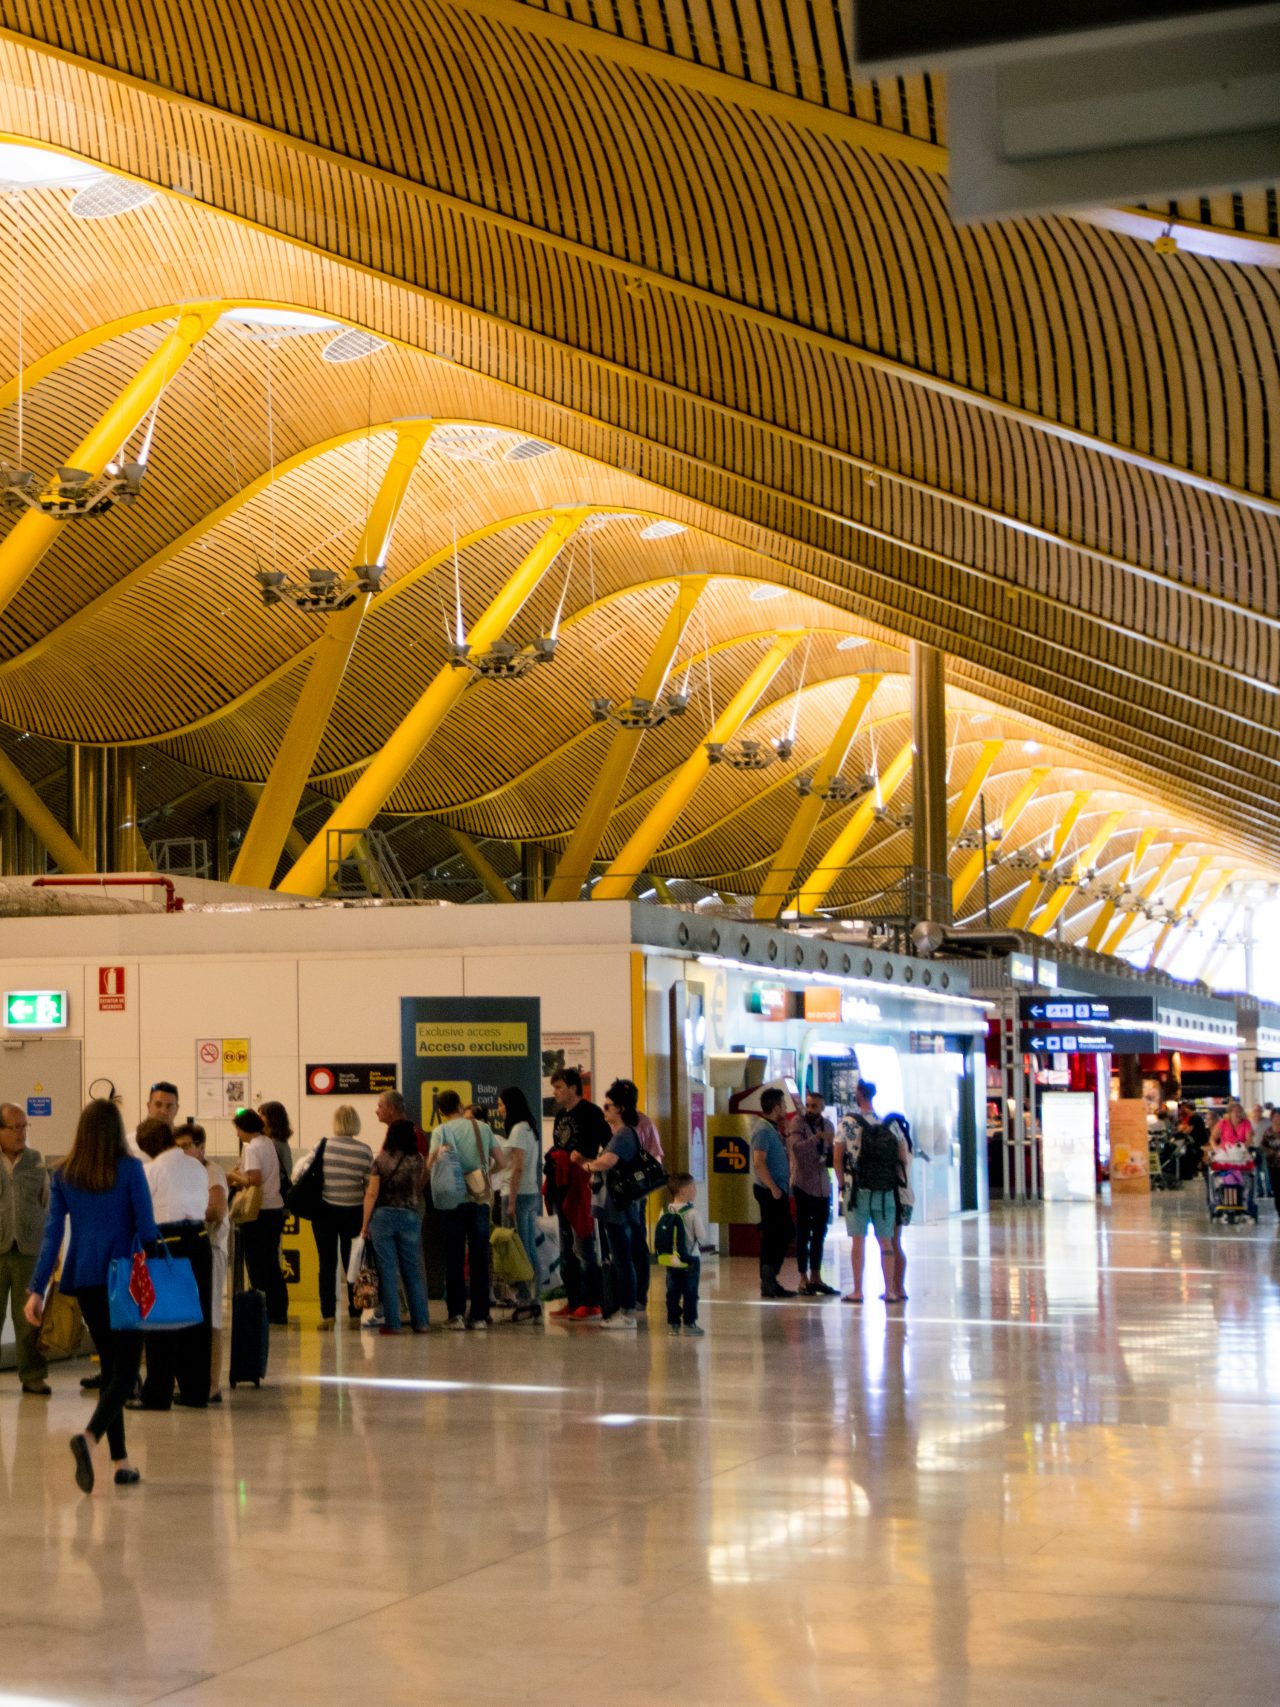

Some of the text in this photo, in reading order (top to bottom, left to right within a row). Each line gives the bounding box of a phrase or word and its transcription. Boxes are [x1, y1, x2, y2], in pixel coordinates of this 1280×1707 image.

[807, 1011, 837, 1020] orange
[420, 1026, 501, 1037] Exclusive access
[420, 1041, 525, 1052] Acceso exclusivo
[477, 1084, 497, 1095] Baby
[477, 1095, 494, 1104] cart
